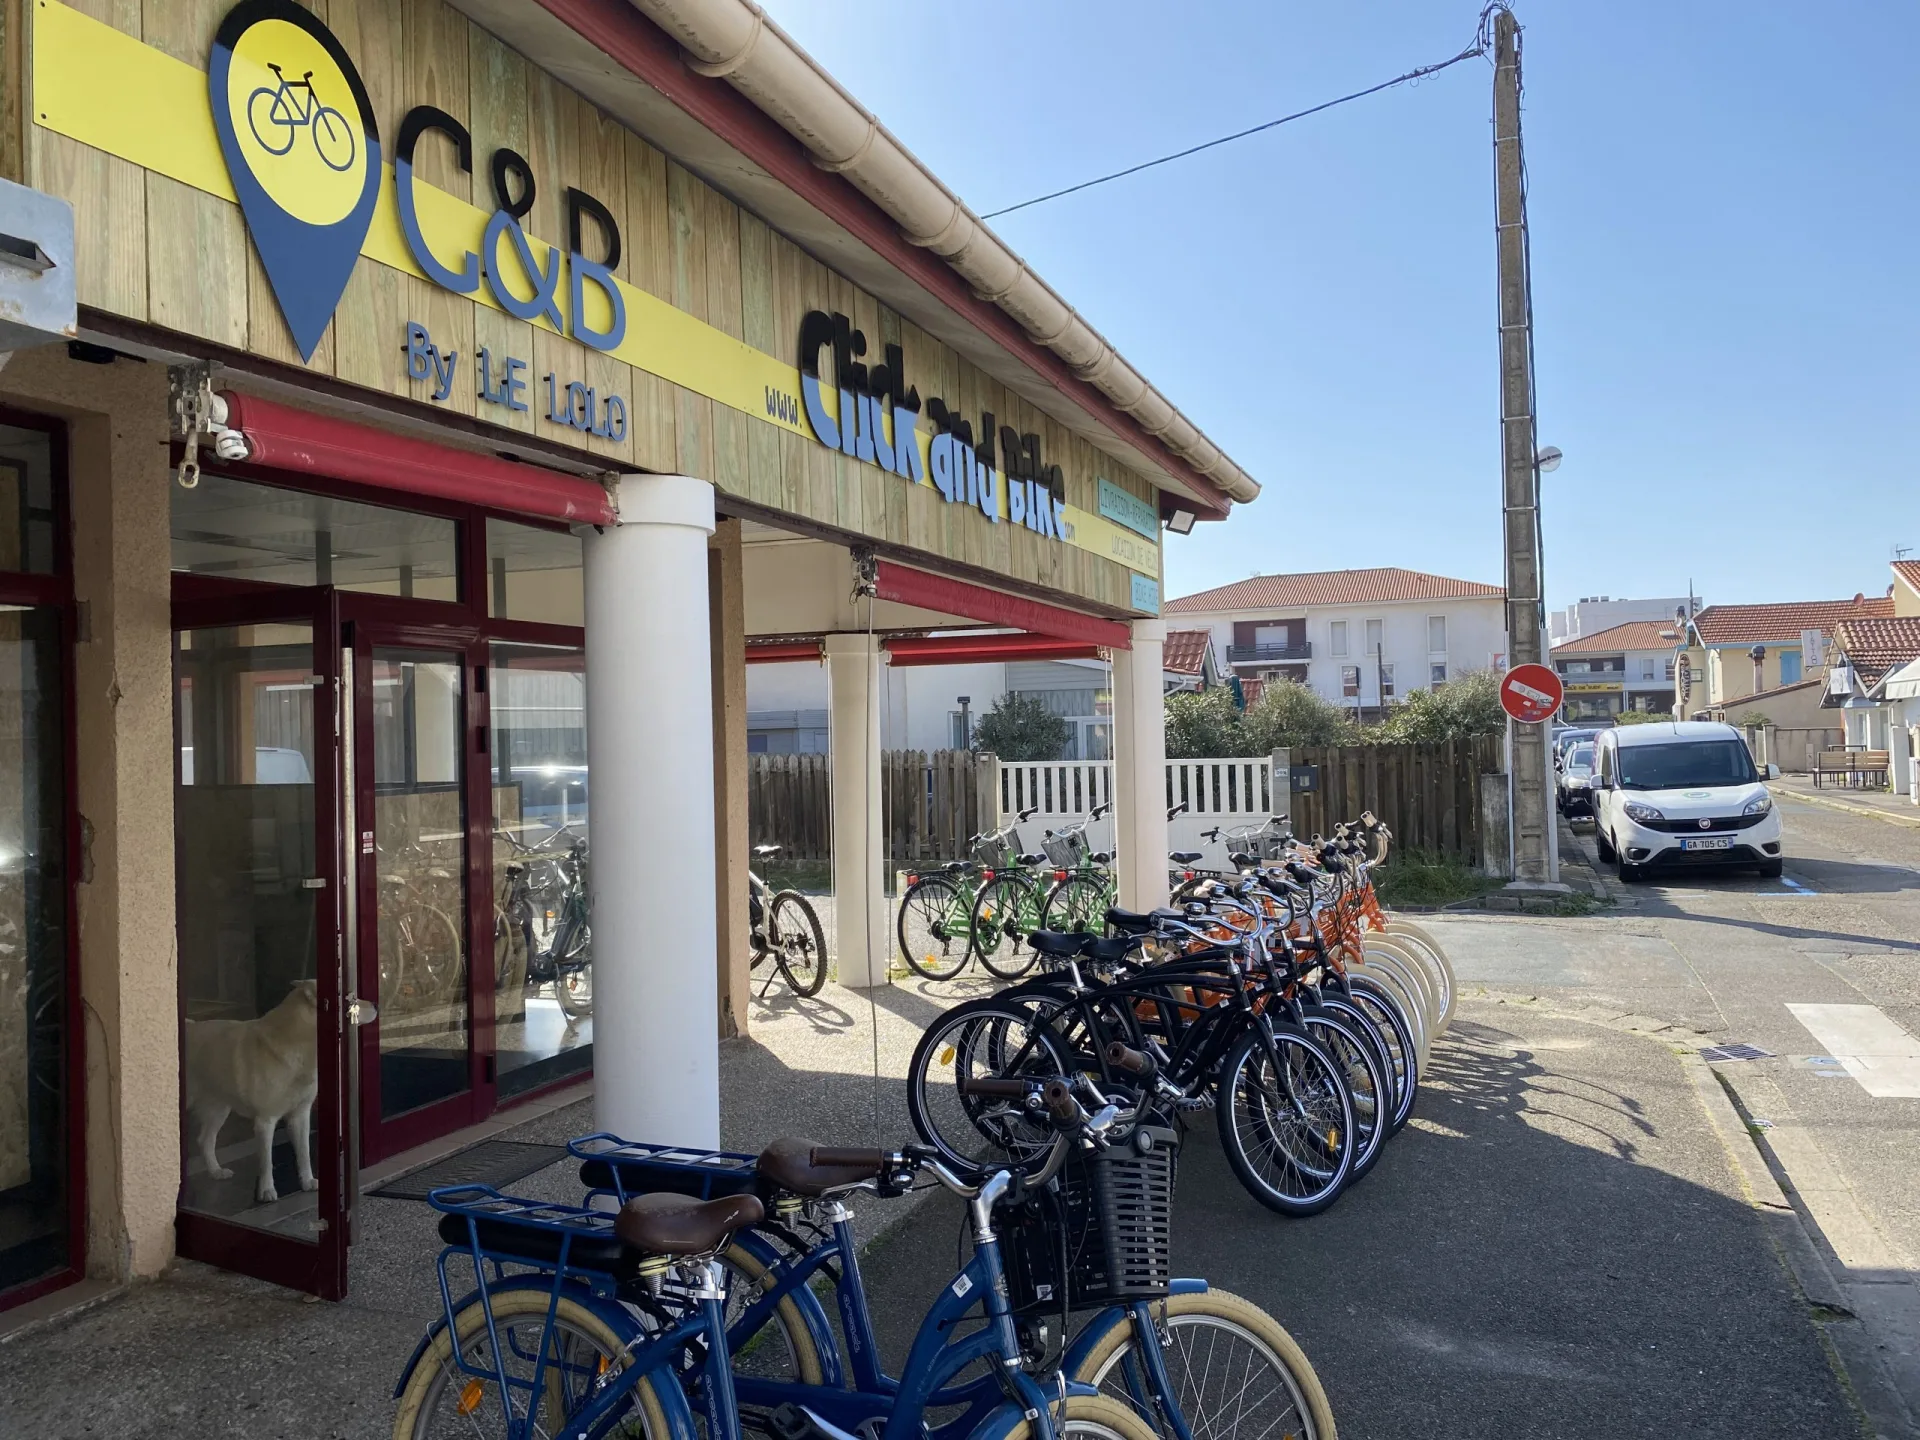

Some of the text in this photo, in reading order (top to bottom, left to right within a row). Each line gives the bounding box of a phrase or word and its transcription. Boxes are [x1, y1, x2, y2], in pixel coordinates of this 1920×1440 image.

[394, 105, 626, 351] C&B
[406, 321, 627, 441] By LE LOLO
[800, 310, 924, 484] Click
[928, 397, 999, 523] and
[1001, 426, 1066, 541] Bike
